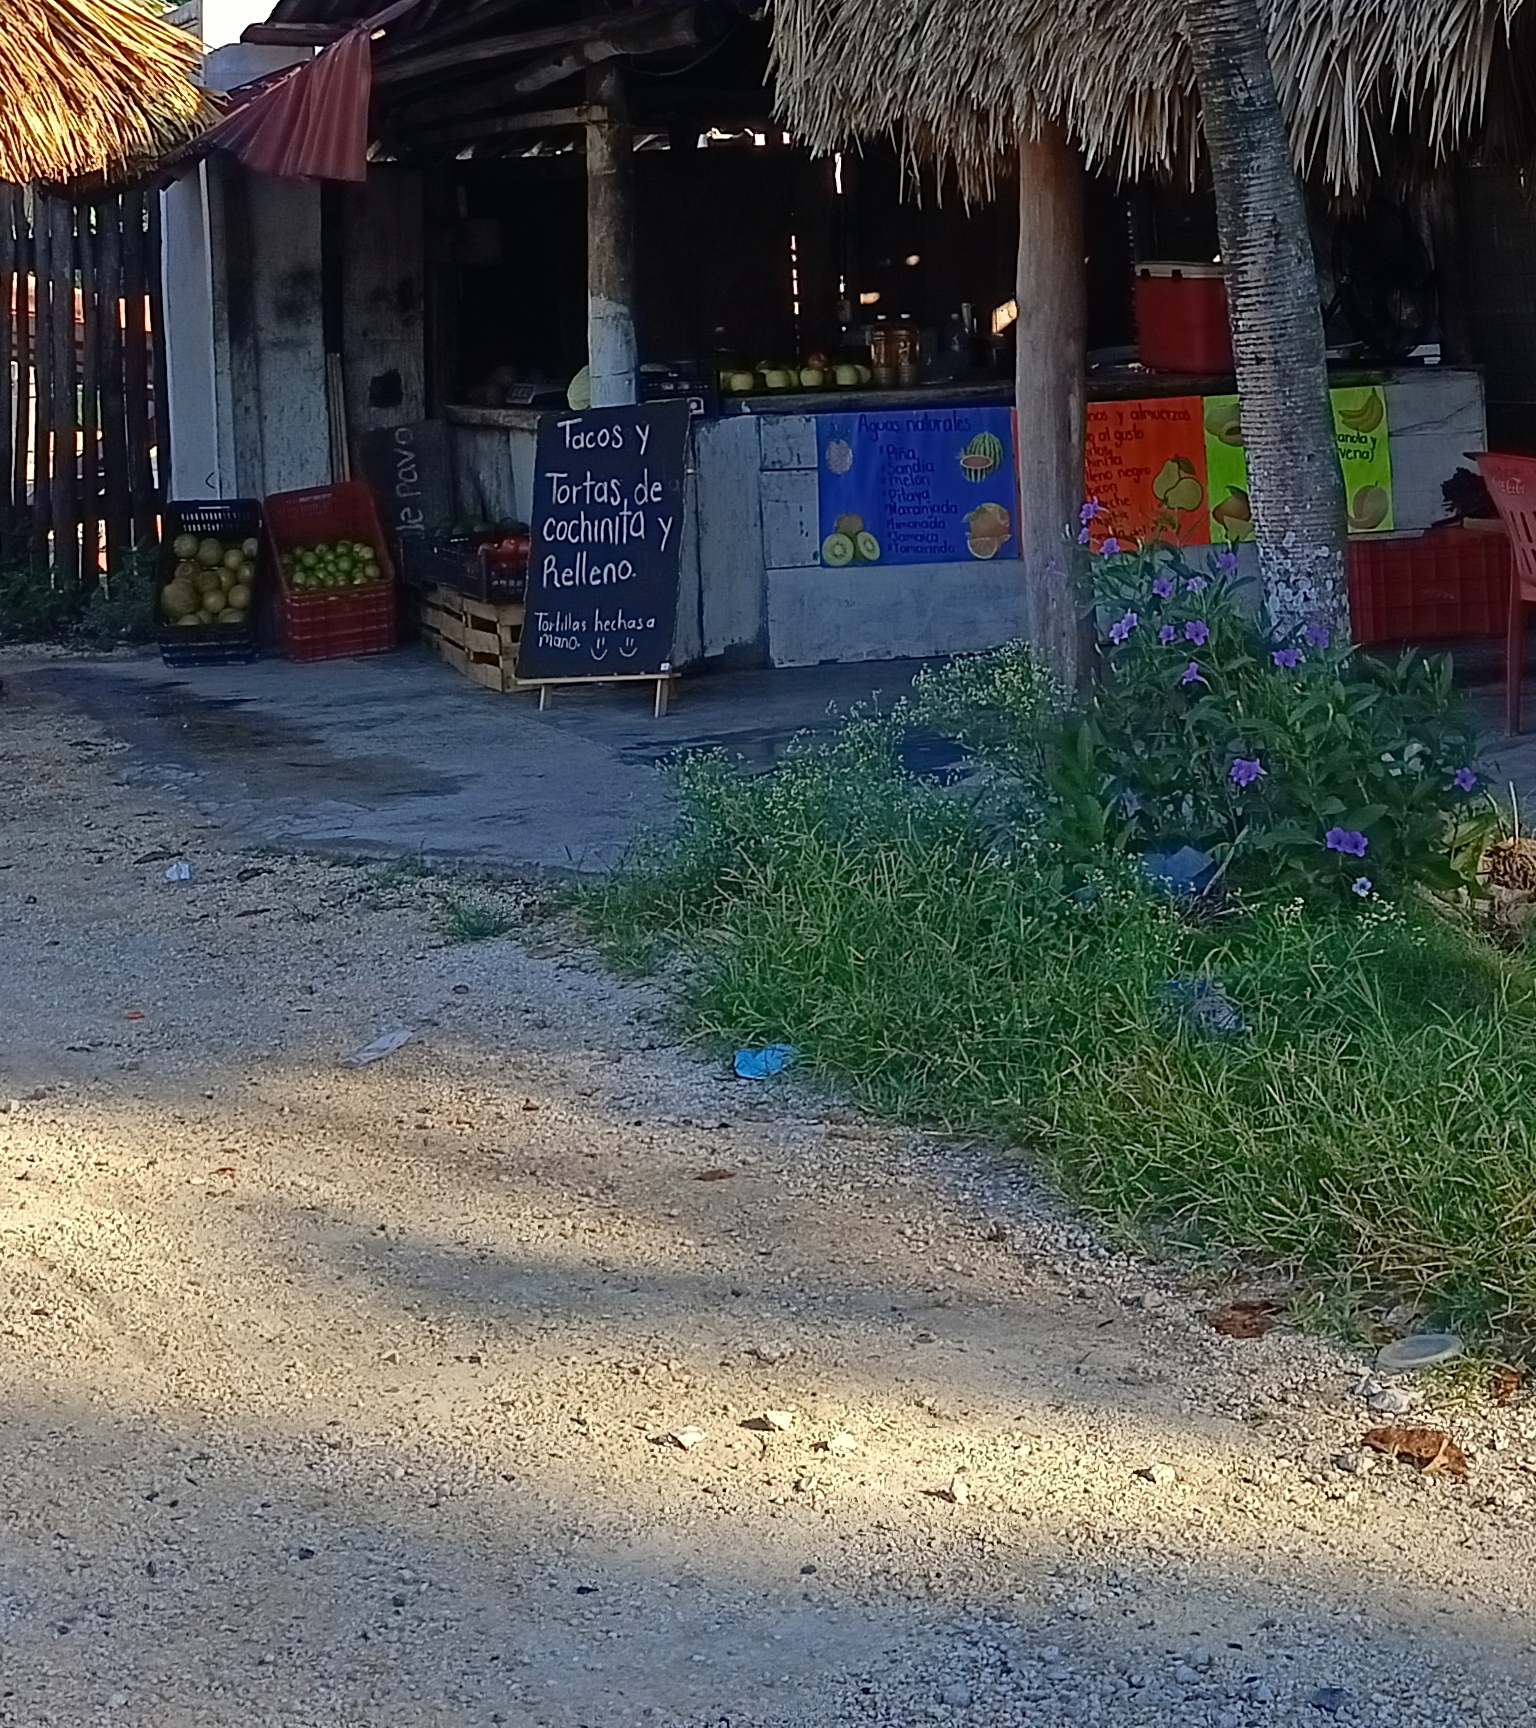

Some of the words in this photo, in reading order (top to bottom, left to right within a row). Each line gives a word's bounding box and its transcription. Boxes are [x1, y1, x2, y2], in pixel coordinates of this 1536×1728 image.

[557, 418, 623, 449] Tacos
[635, 423, 650, 456] y
[858, 414, 900, 443] Aguas
[905, 410, 971, 433] naturales
[1114, 423, 1144, 448] gusto
[544, 470, 621, 506] Tortas
[634, 468, 663, 506] de
[1117, 467, 1151, 484] negro
[888, 487, 930, 504] Pitaya
[542, 498, 645, 546] cochinita
[657, 516, 673, 552] y
[893, 540, 955, 554] Tamarindo
[534, 611, 587, 633] Tortillas
[594, 608, 644, 632] hechas
